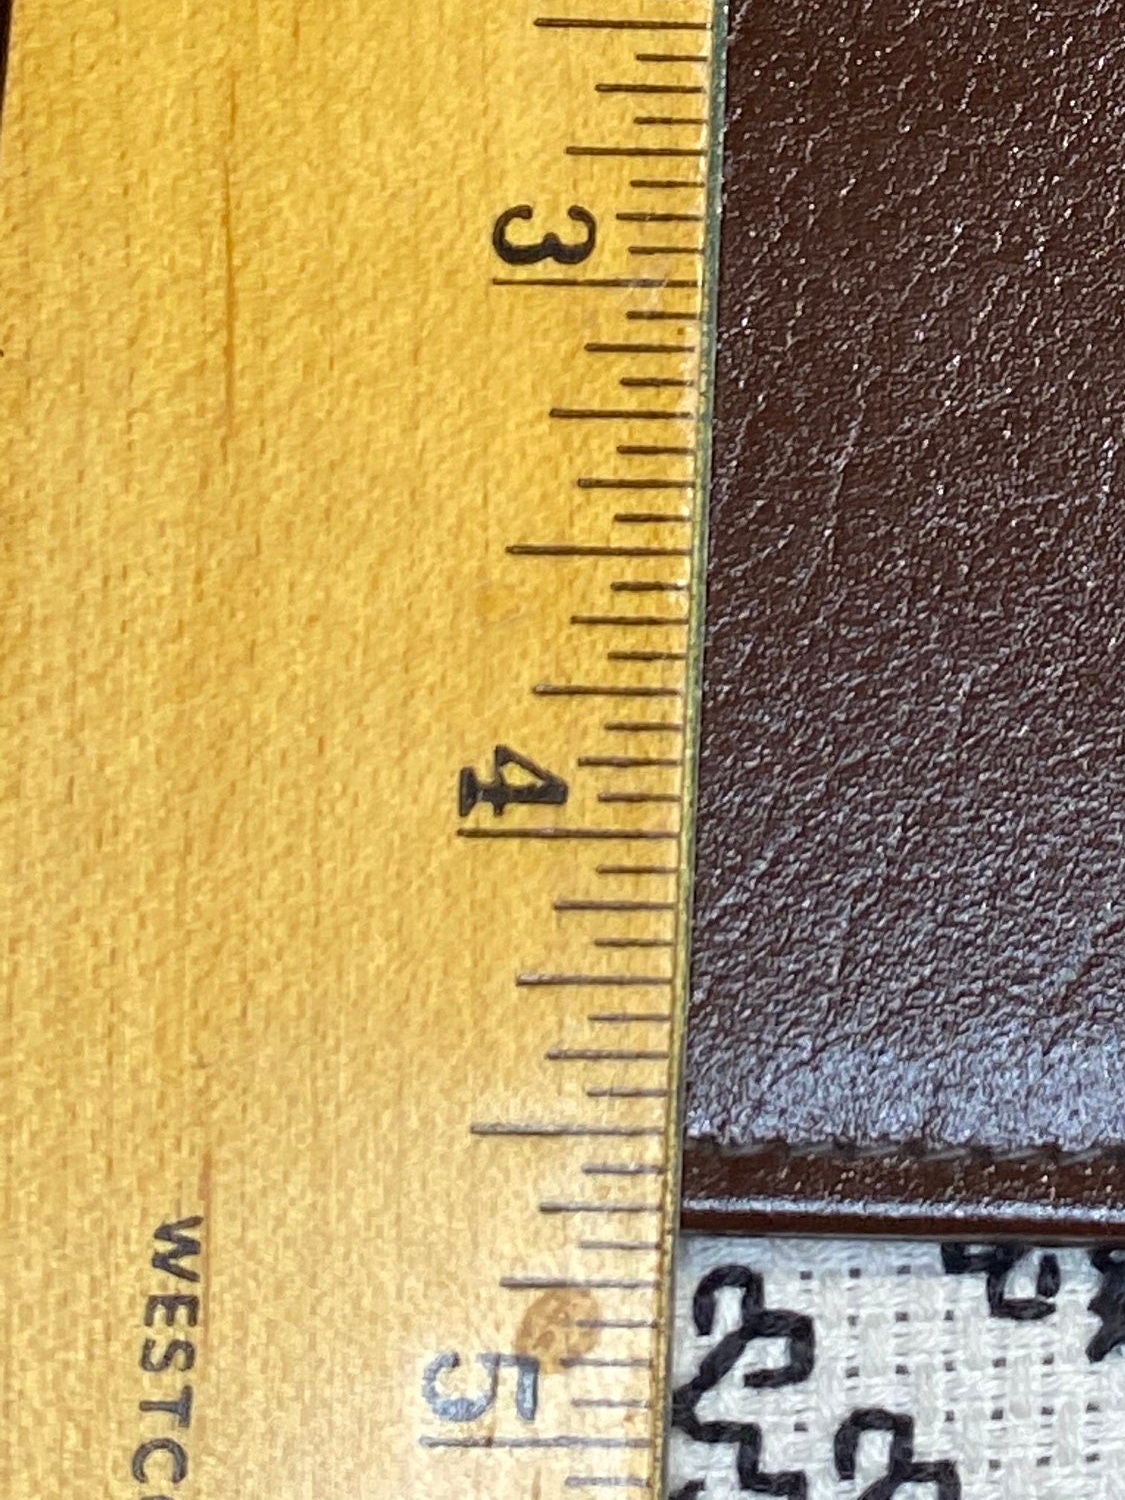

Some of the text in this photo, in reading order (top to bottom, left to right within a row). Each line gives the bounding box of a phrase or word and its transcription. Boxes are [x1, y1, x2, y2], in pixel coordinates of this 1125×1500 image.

[492, 204, 597, 265] 3
[458, 744, 568, 817] 4
[132, 1214, 204, 1500] WESTC
[421, 1350, 539, 1421] 5
